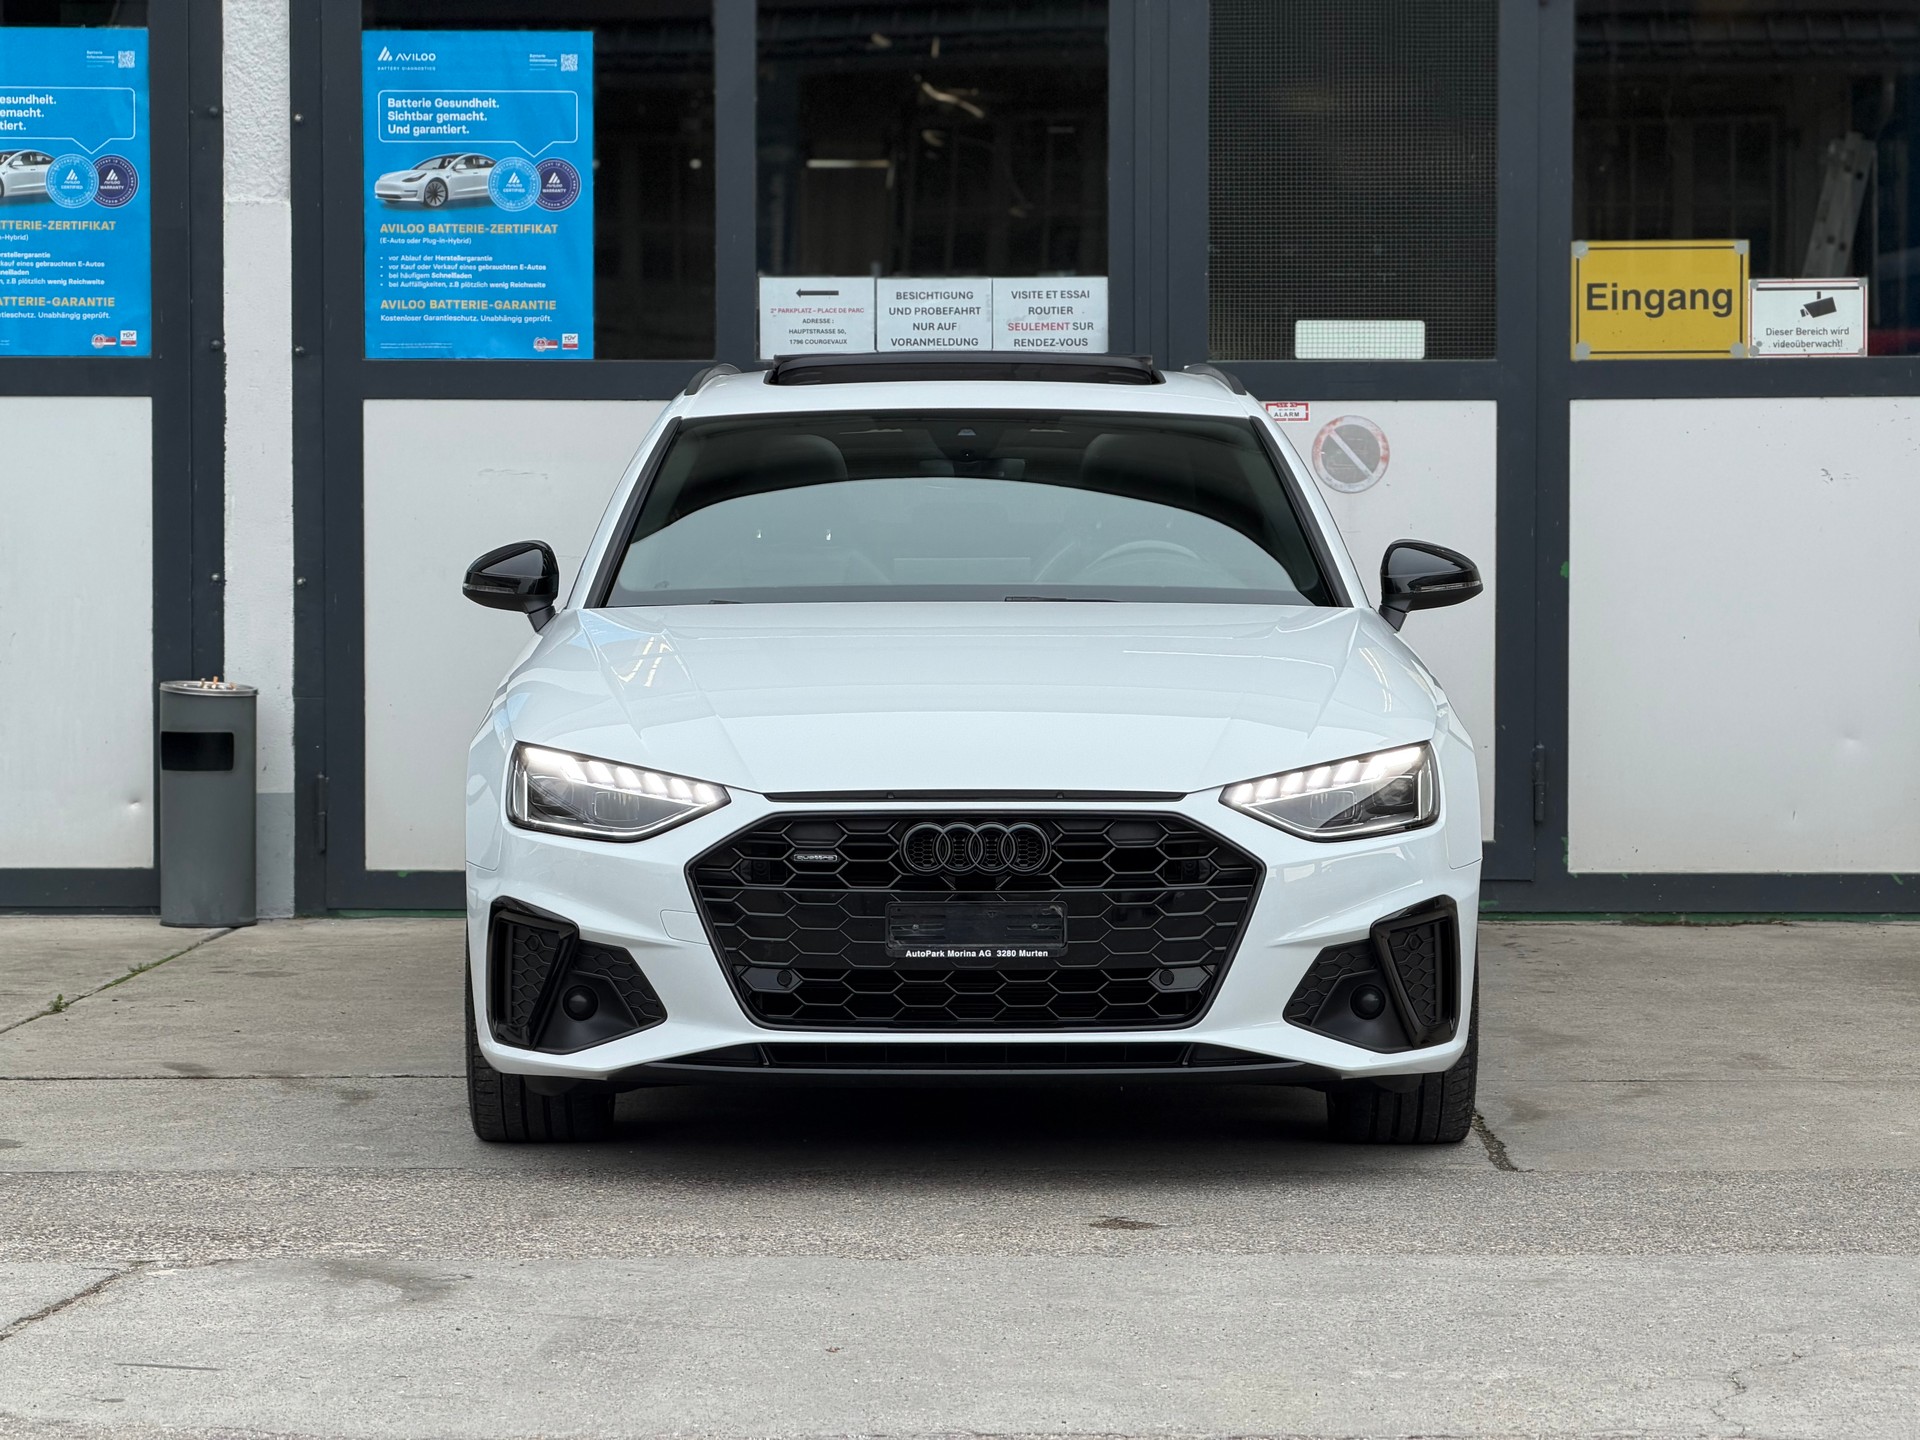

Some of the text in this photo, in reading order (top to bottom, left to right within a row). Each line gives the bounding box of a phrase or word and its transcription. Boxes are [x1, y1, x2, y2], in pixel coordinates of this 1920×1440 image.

[395, 53, 436, 61] AVILOO
[388, 98, 500, 108] Batterie Gesundheit.
[388, 111, 488, 123] Sichtbar gemacht.
[388, 124, 470, 136] Und garantiert.
[0, 220, 116, 230] TTERIE-ZERTIFIKAT
[380, 224, 558, 234] AVILOO BATTERIE-ZERTIFIKAT
[896, 291, 974, 300] BESICHTIGUNG
[1011, 290, 1090, 300] VISITE ET ESSAI
[1586, 282, 1733, 318] Eingang
[381, 300, 556, 310] AVILOO BATTERIE-GARANTIE
[888, 306, 982, 316] UND PROBEFAHRT
[1028, 306, 1074, 315] ROUTIER
[912, 322, 957, 331] NUR AUF
[1008, 322, 1094, 331] SEULEMENT SUR
[1766, 326, 1850, 336] Dieser Bereich wird
[890, 338, 979, 346] VORANMELDUNG
[1013, 338, 1088, 347] RENDEZ-VOUS
[1772, 338, 1843, 348] videoüberwacht!
